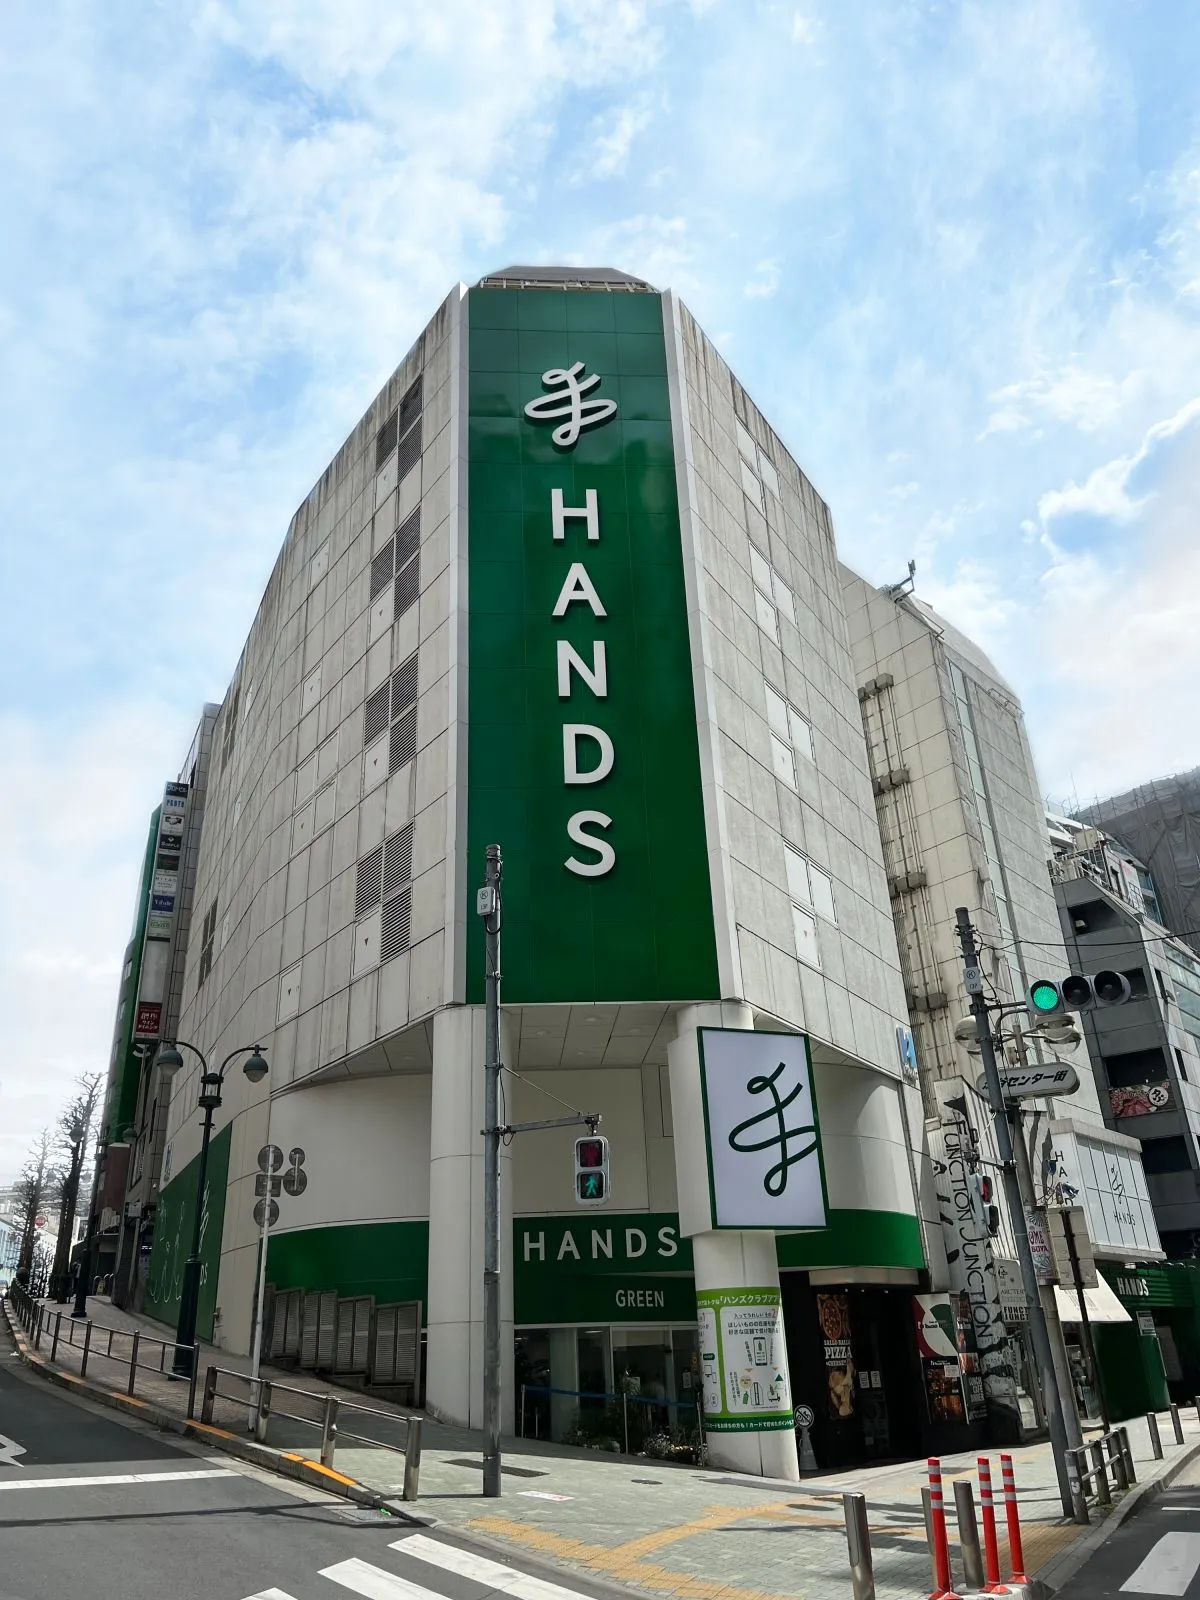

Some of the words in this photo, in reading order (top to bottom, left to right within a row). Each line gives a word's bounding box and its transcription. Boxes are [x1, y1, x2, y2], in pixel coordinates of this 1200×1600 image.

[551, 488, 616, 877] HANDS
[1113, 1210, 1136, 1227] HANDS
[523, 1226, 678, 1261] HANDS
[960, 1227, 993, 1337] JUNCTION
[1117, 1277, 1149, 1296] HANDS
[615, 1289, 664, 1308] GREEN
[823, 1346, 853, 1360] PIZZA
